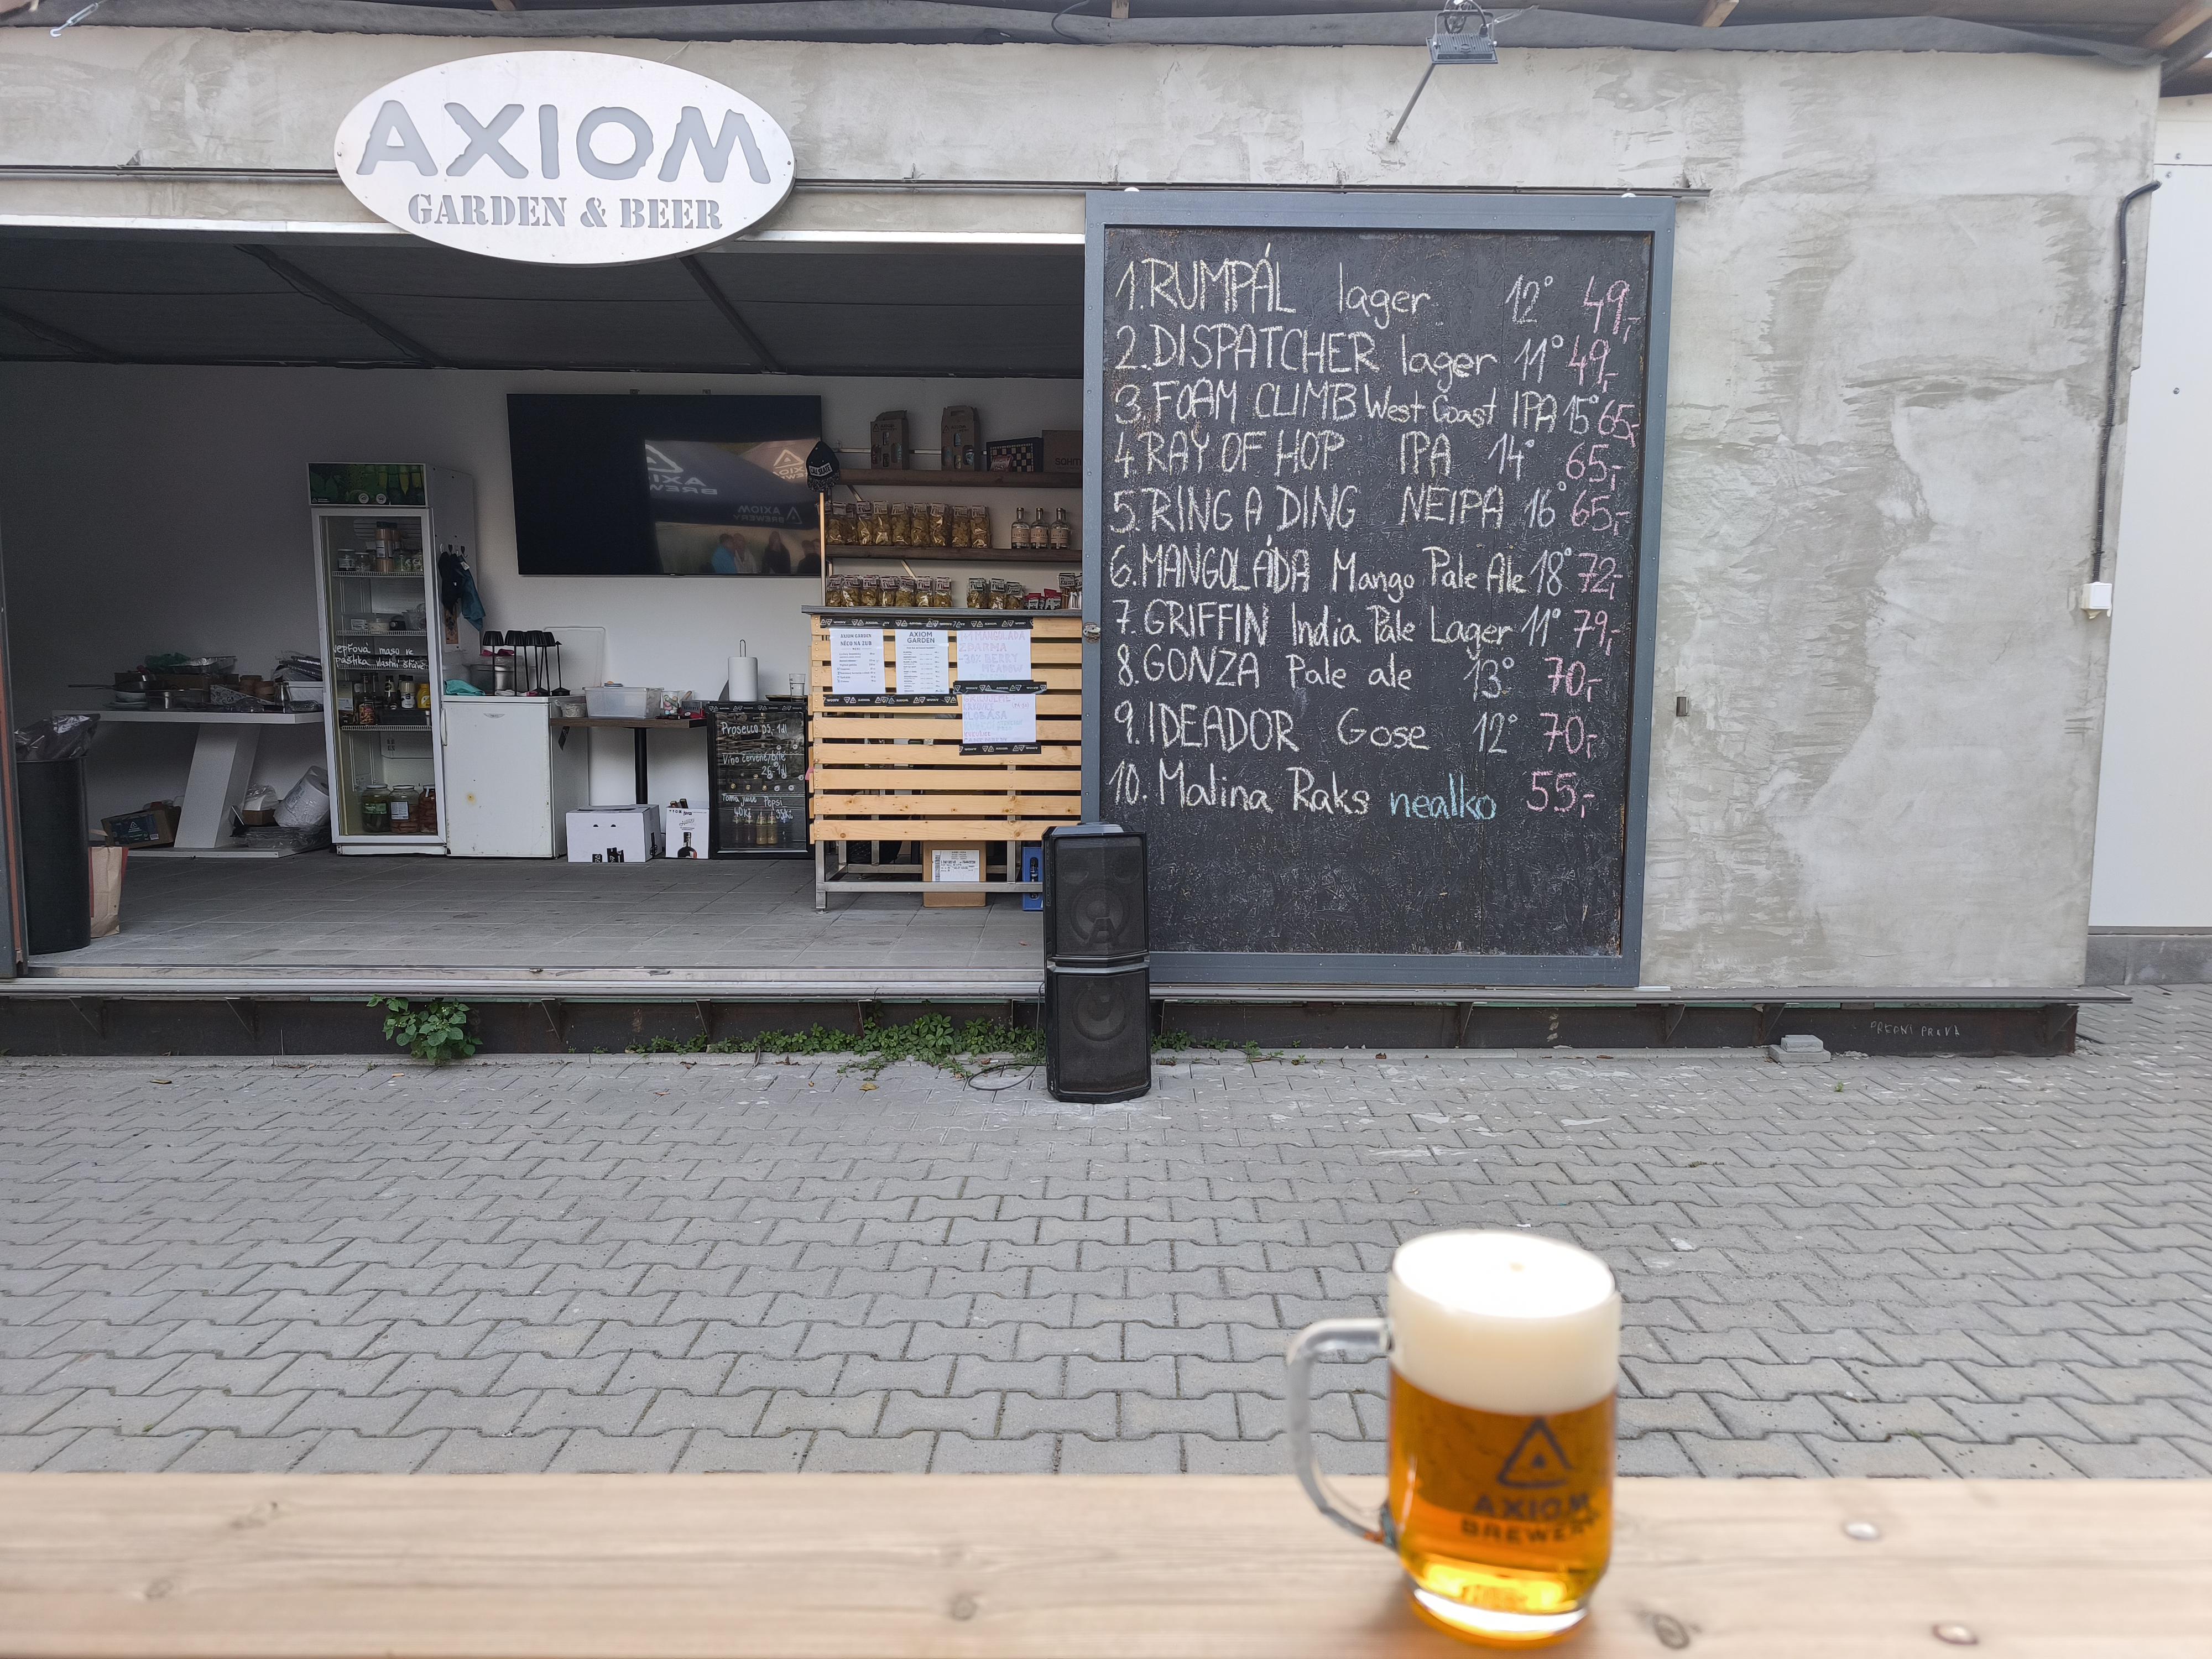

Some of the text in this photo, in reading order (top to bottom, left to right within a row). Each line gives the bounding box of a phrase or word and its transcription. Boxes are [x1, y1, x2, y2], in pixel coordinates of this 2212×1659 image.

[356, 100, 771, 184] AXIOM
[408, 193, 723, 230] GARDEN & BEER
[1338, 262, 1431, 330] lager
[1400, 334, 1498, 393] lager
[1364, 384, 1426, 424] West
[1432, 387, 1496, 429] Coast
[1512, 390, 1558, 434] IPA
[1222, 431, 1268, 474] OF
[1274, 428, 1345, 478] HOP
[1400, 431, 1452, 479] IPA
[1245, 486, 1263, 533] A
[1275, 483, 1358, 533] DING
[1397, 483, 1504, 531] NEIPA
[1331, 548, 1416, 603] Mango
[1422, 546, 1478, 589] Pale
[1486, 552, 1528, 594] Ale
[1292, 602, 1361, 647] India
[1366, 604, 1416, 645] Pale
[1430, 605, 1514, 661] Lager
[1285, 653, 1347, 690] Pale
[1368, 653, 1412, 691] ale
[1337, 707, 1431, 751] Gose
[763, 796, 783, 811] Pepsi
[1159, 758, 1274, 816] Malina
[1286, 766, 1371, 816] Raks
[1390, 773, 1498, 821] nealko
[1473, 1491, 1591, 1522] AXIOM
